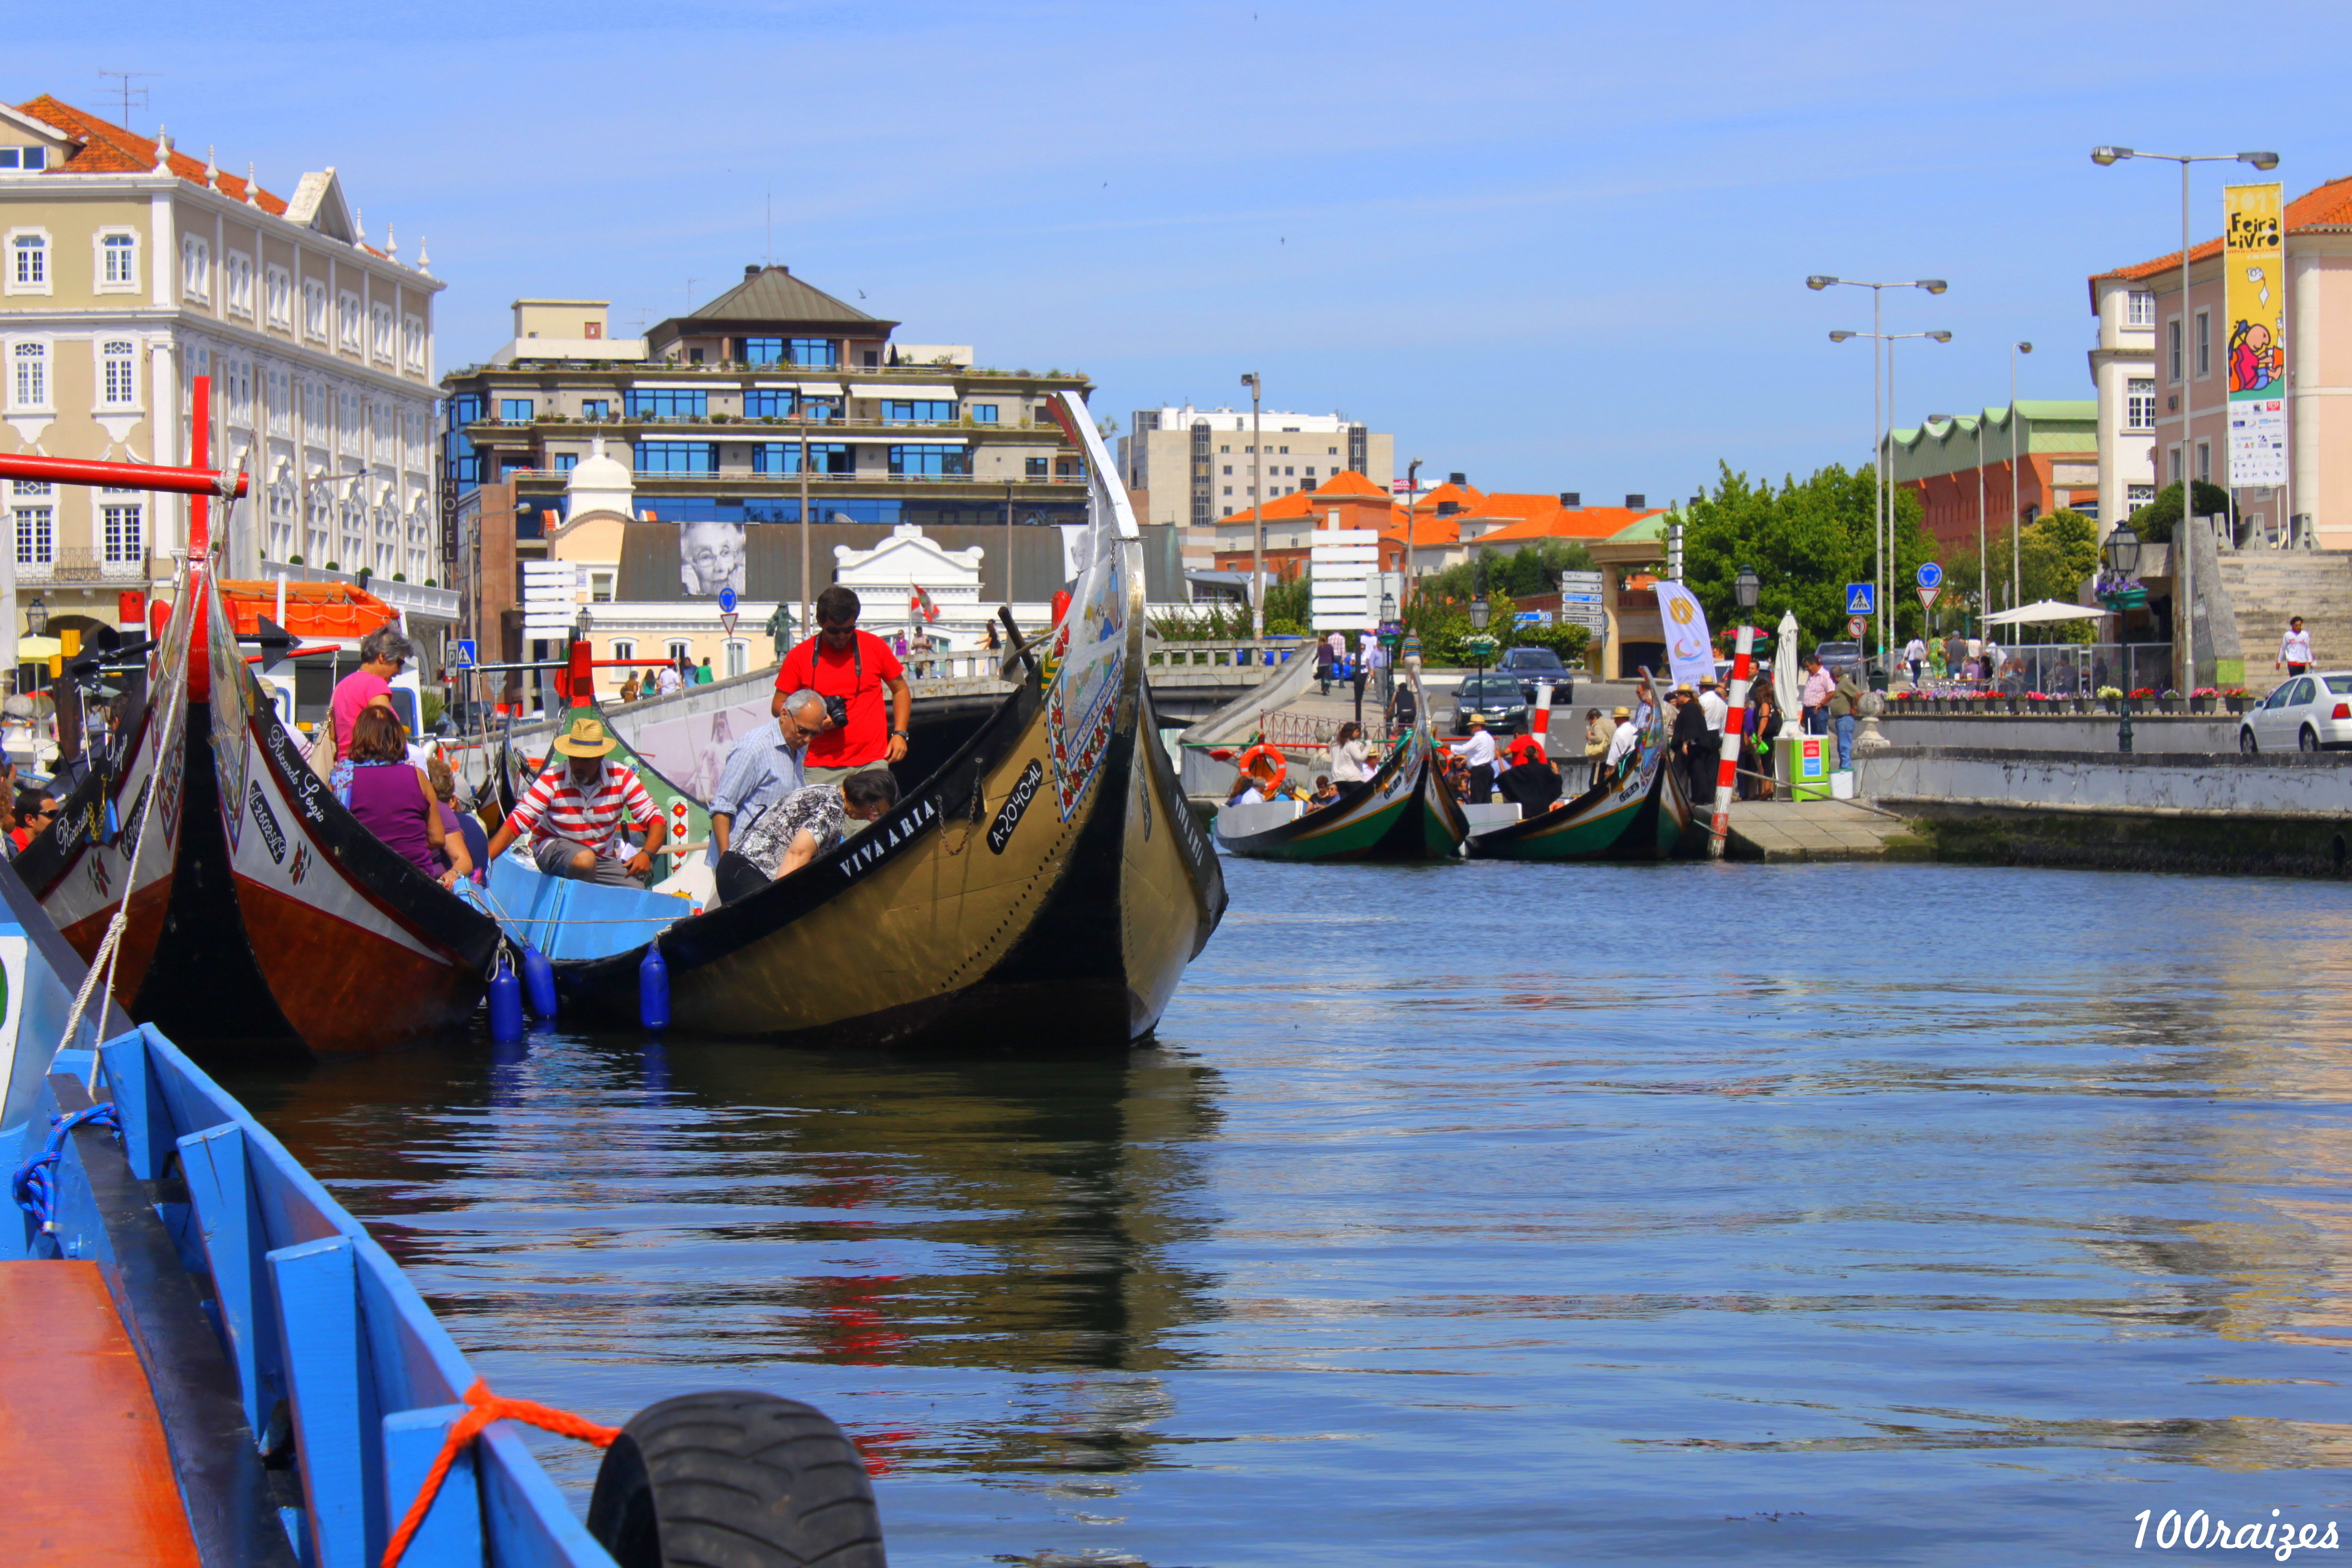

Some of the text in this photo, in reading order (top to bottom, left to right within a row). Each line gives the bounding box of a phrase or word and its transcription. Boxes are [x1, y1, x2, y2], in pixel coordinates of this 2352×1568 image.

[2227, 191, 2280, 216] 2011
[2231, 212, 2277, 233] Feira
[443, 482, 456, 560] HOTEL
[268, 724, 299, 785] Ricardo
[992, 765, 1041, 847] A-2040-AL
[839, 839, 885, 878] VIVA
